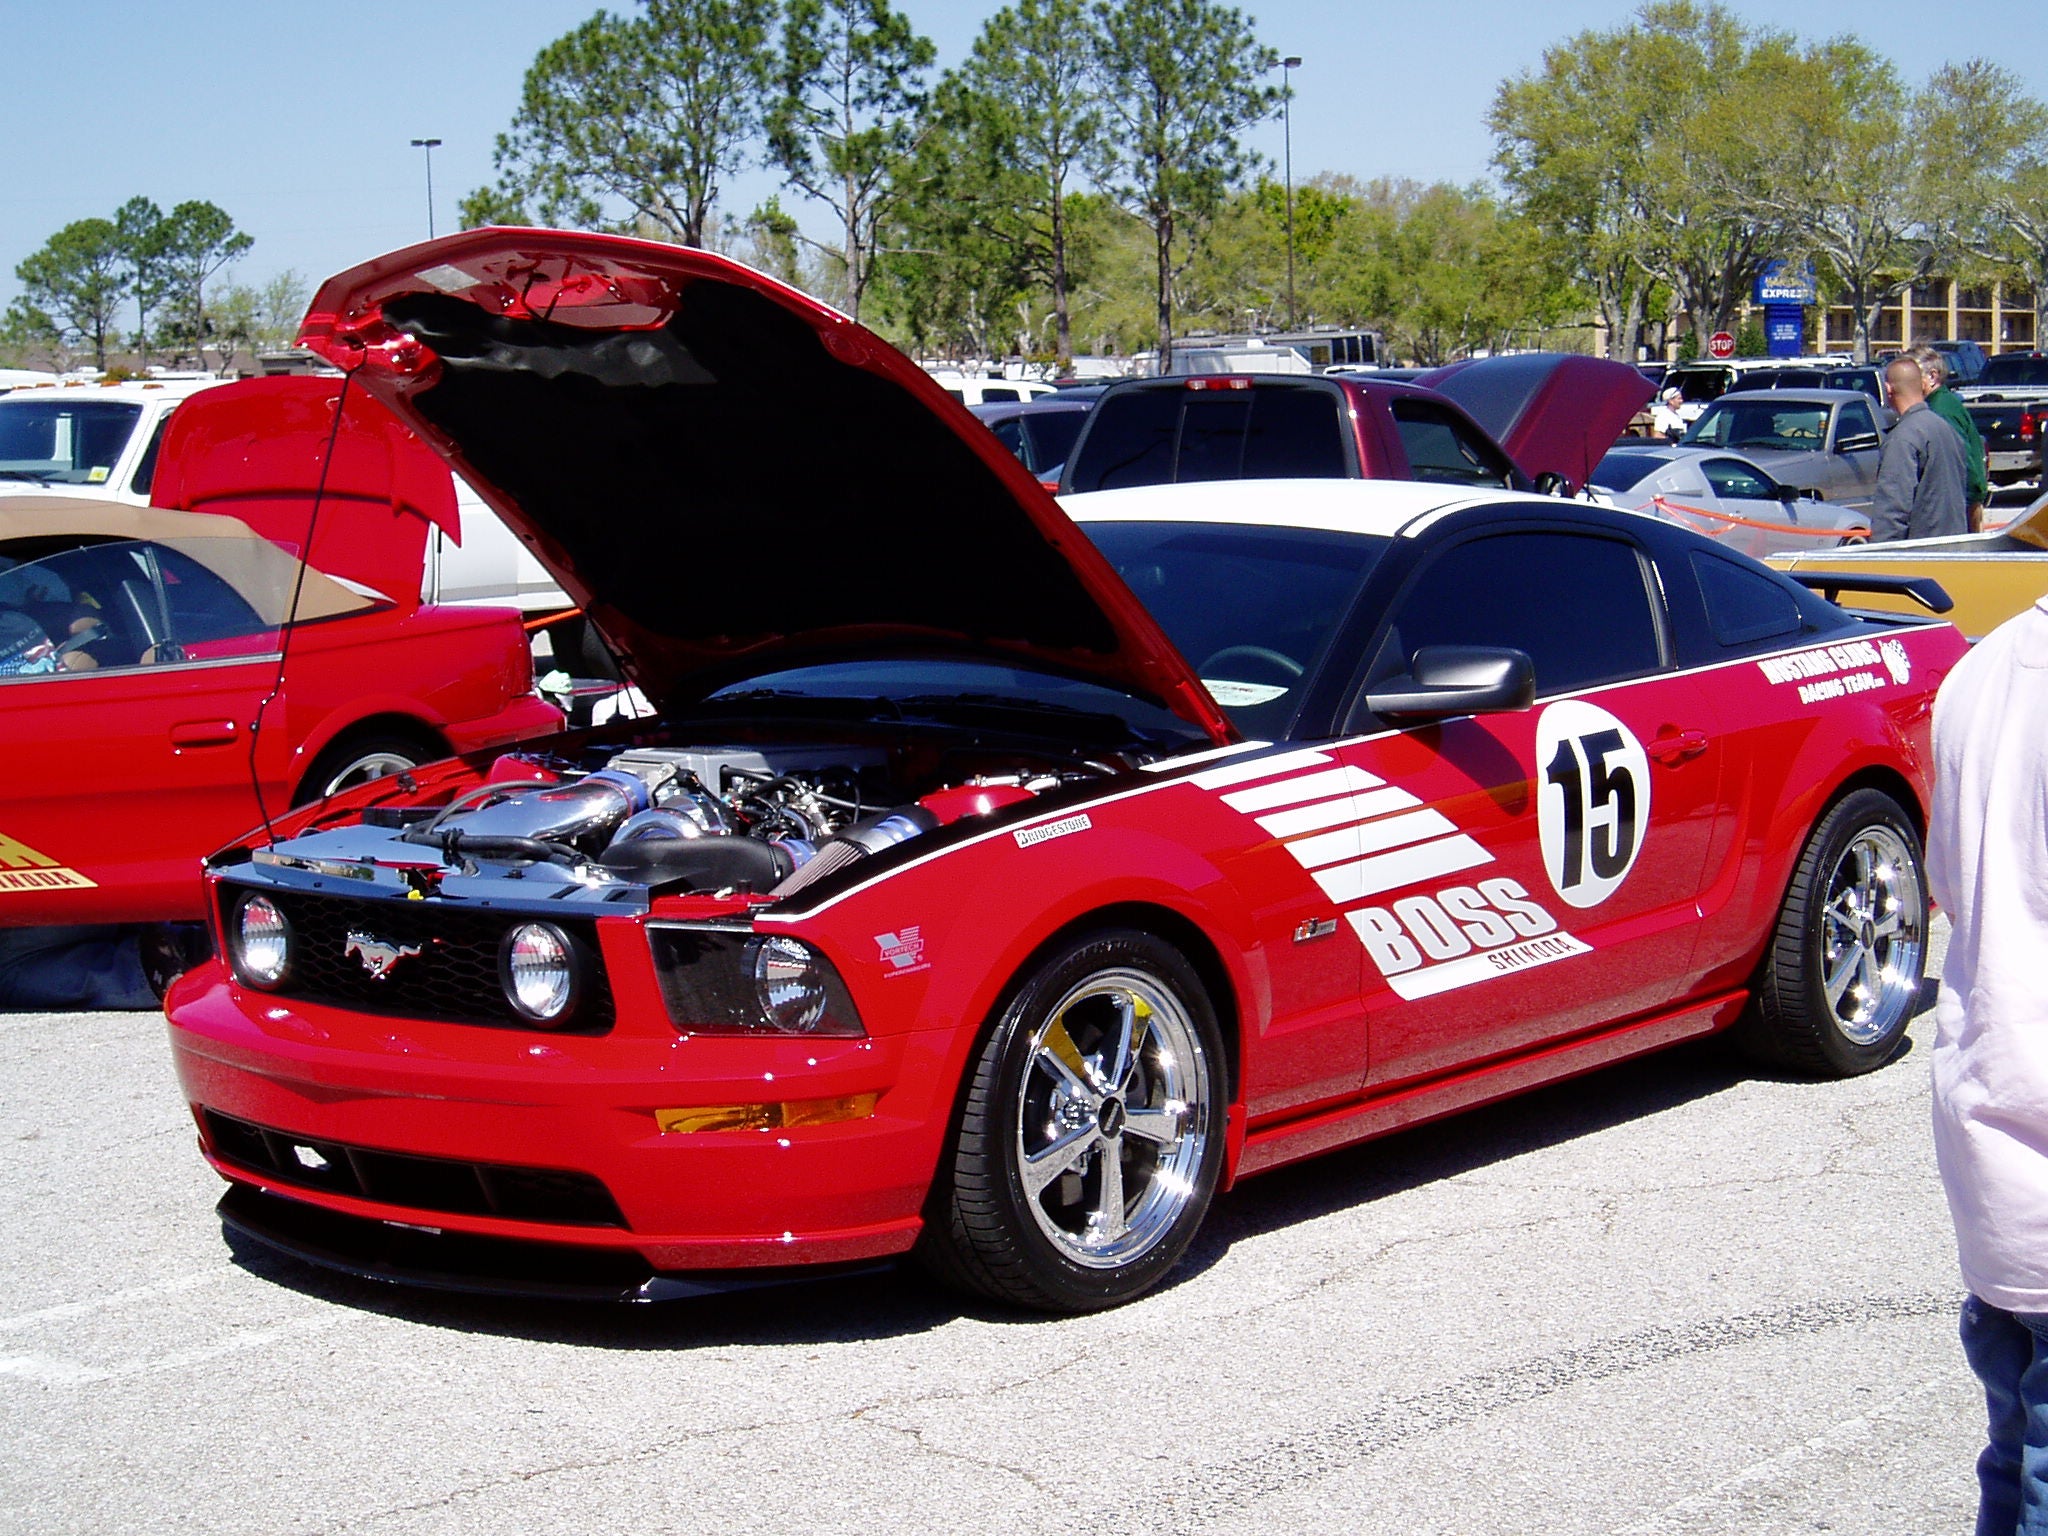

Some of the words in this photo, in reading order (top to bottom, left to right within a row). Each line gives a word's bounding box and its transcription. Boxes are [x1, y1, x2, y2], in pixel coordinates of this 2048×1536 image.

[1710, 340, 1733, 351] STOP
[1757, 649, 1839, 685] MUSTANG
[1798, 678, 1845, 705] RACING
[1545, 728, 1636, 890] 15
[1016, 816, 1089, 845] BRIDGESTONE
[1344, 877, 1557, 977] BOSS
[1488, 937, 1577, 971] SHINODA
